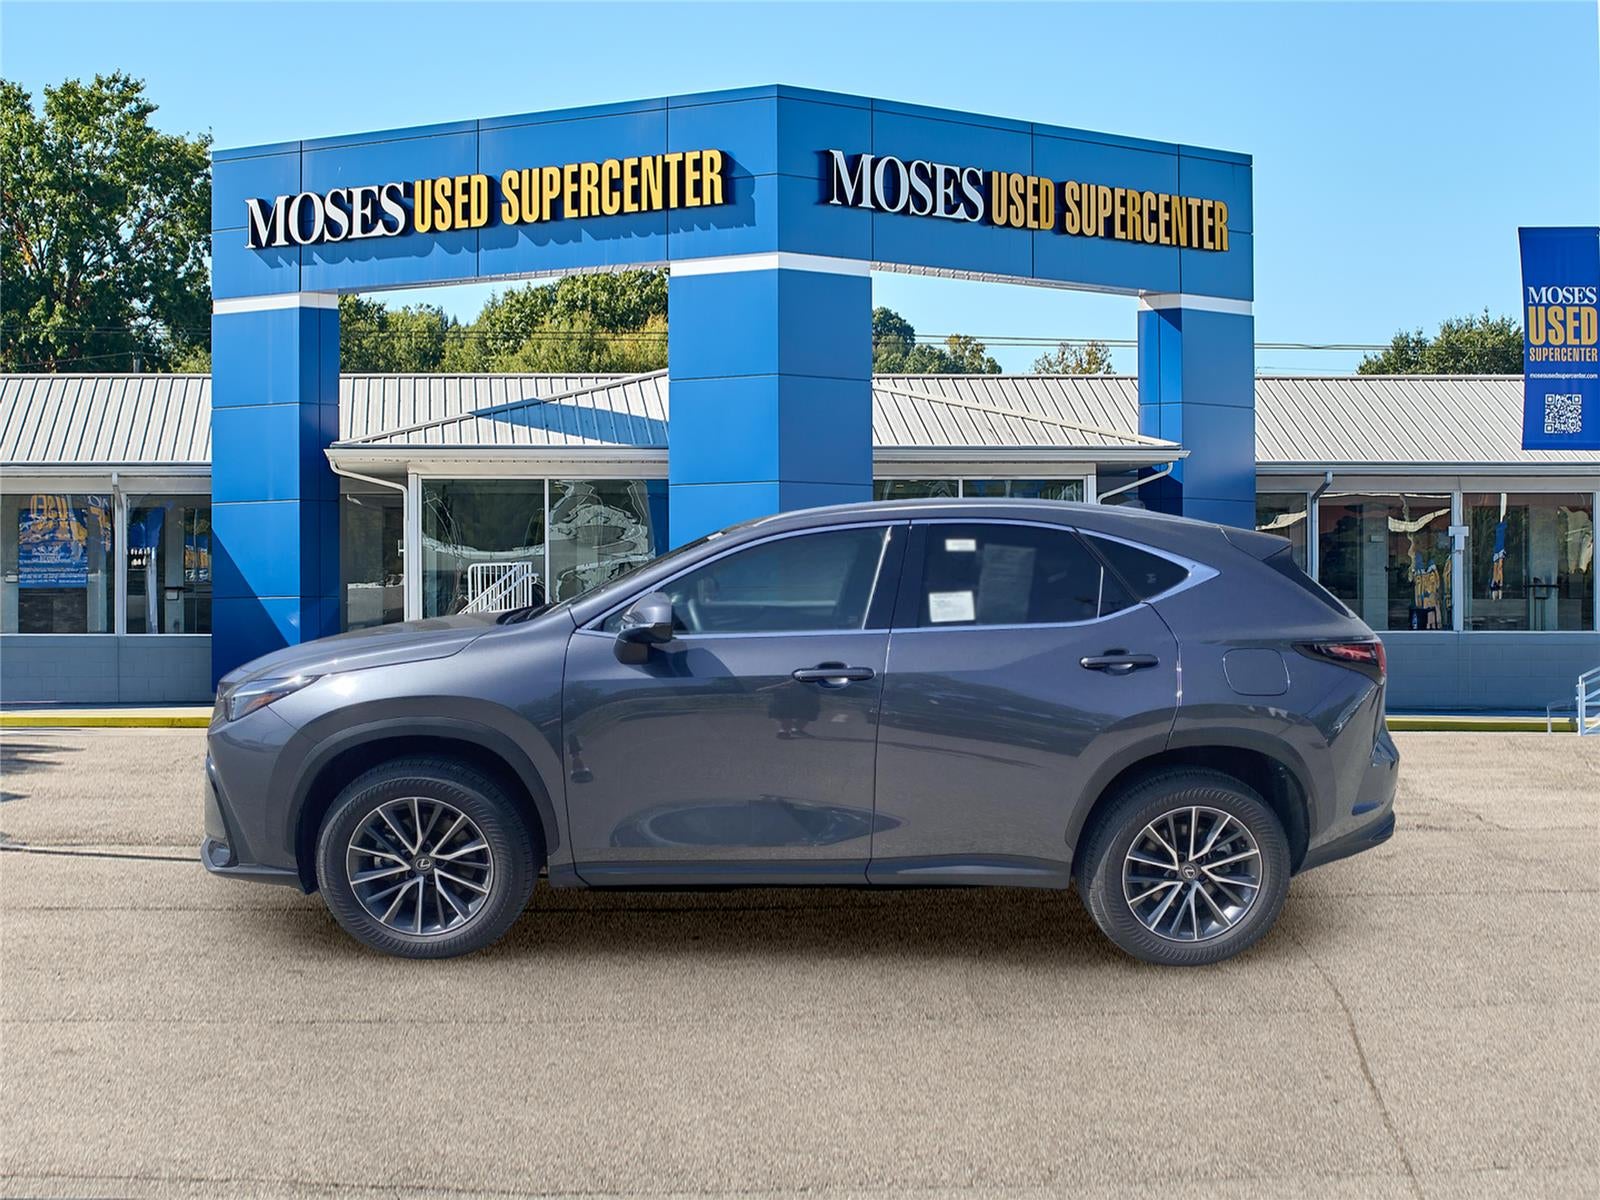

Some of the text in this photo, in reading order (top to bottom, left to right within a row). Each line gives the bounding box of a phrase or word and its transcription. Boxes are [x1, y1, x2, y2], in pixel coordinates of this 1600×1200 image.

[245, 149, 724, 249] MOSES USED SUPERCENTER
[829, 149, 1229, 251] MOSES USED SUPERCENTER
[1527, 286, 1598, 305] MOSES
[1528, 306, 1598, 346] USED
[1529, 347, 1598, 362] SUPERCENTER
